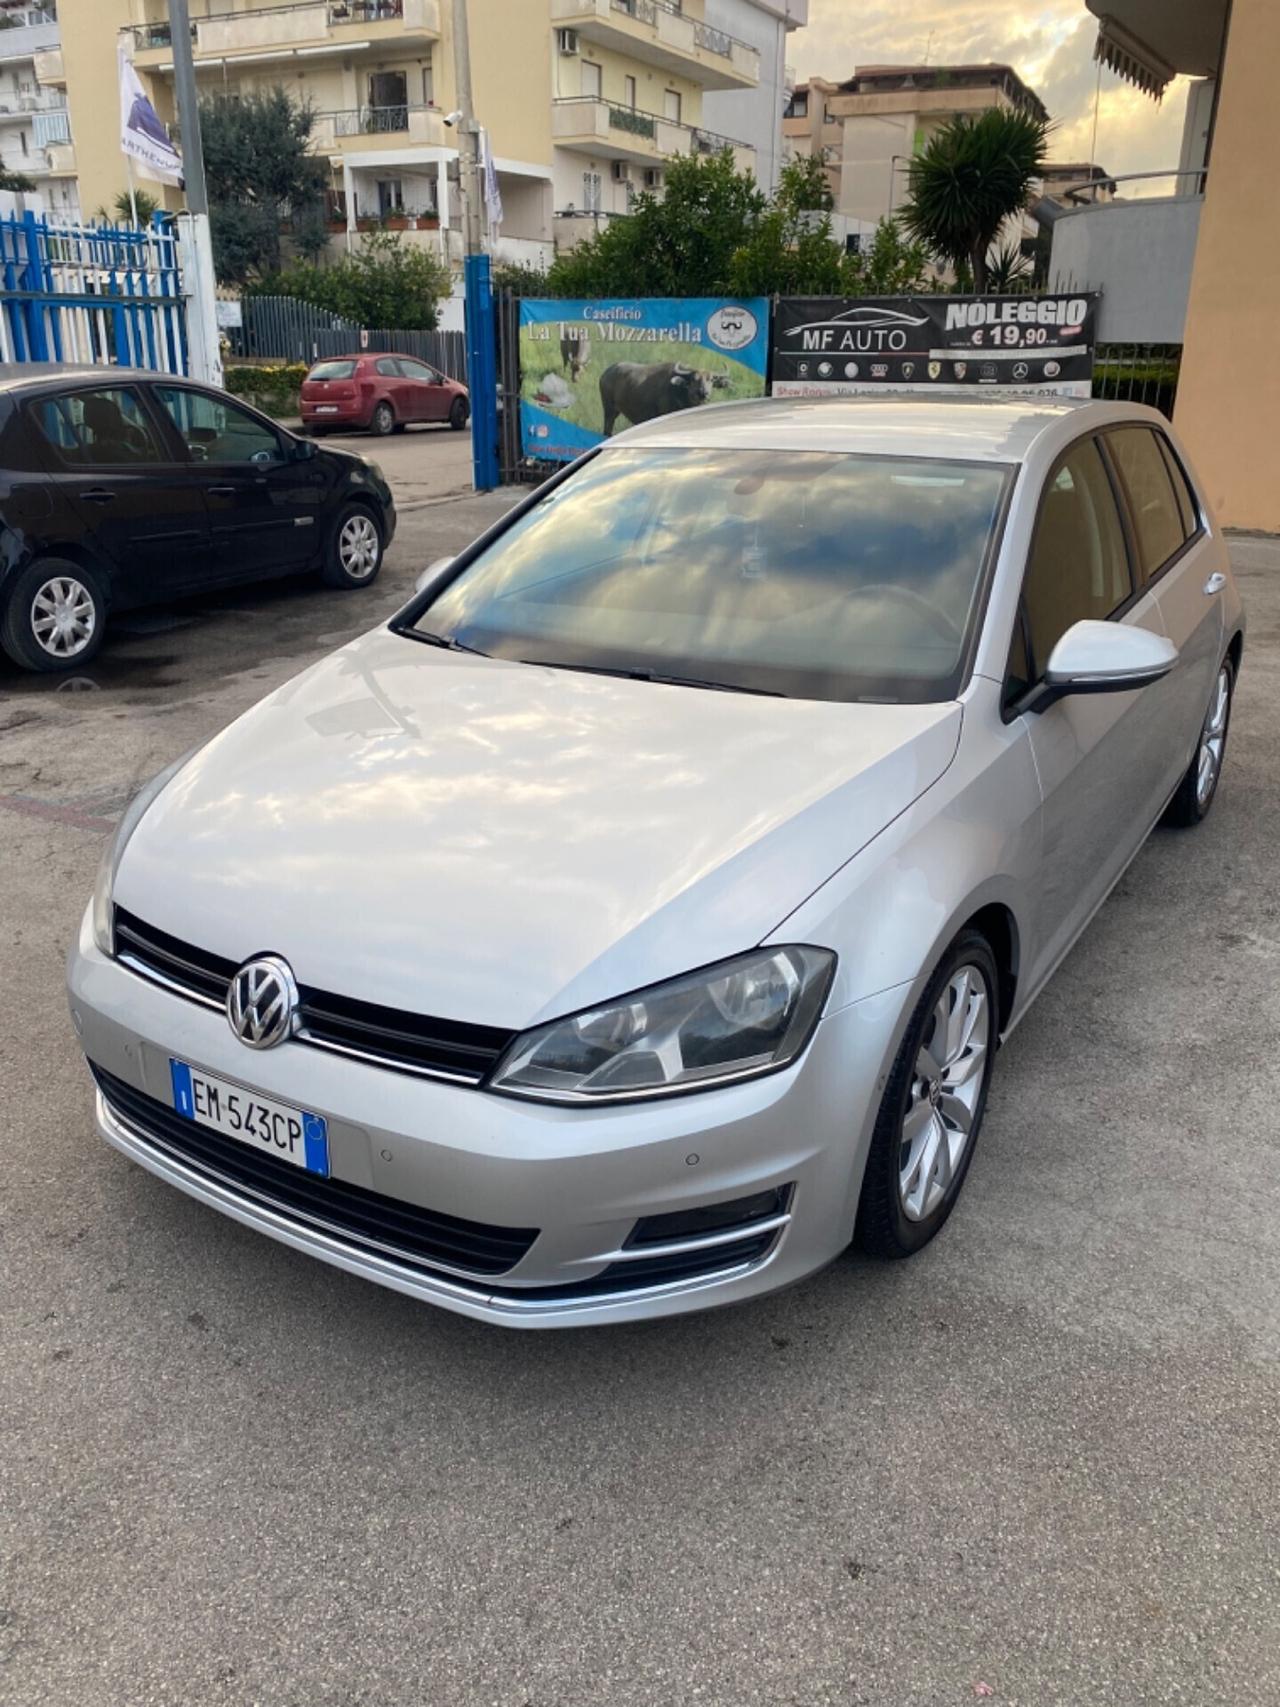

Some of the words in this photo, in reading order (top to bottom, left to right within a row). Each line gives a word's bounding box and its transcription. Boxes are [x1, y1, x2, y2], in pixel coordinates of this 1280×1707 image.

[583, 305, 642, 321] Caseificio
[944, 299, 1088, 331] NOLEGGIO
[527, 319, 551, 341] La
[557, 320, 589, 342] Tua
[597, 321, 702, 343] Mozzarella
[802, 329, 835, 351] MF
[839, 329, 907, 351] AUTO
[971, 329, 984, 345] €
[990, 325, 1047, 348] 19,90
[192, 1078, 221, 1122] EM
[227, 1095, 302, 1153] 543CP
